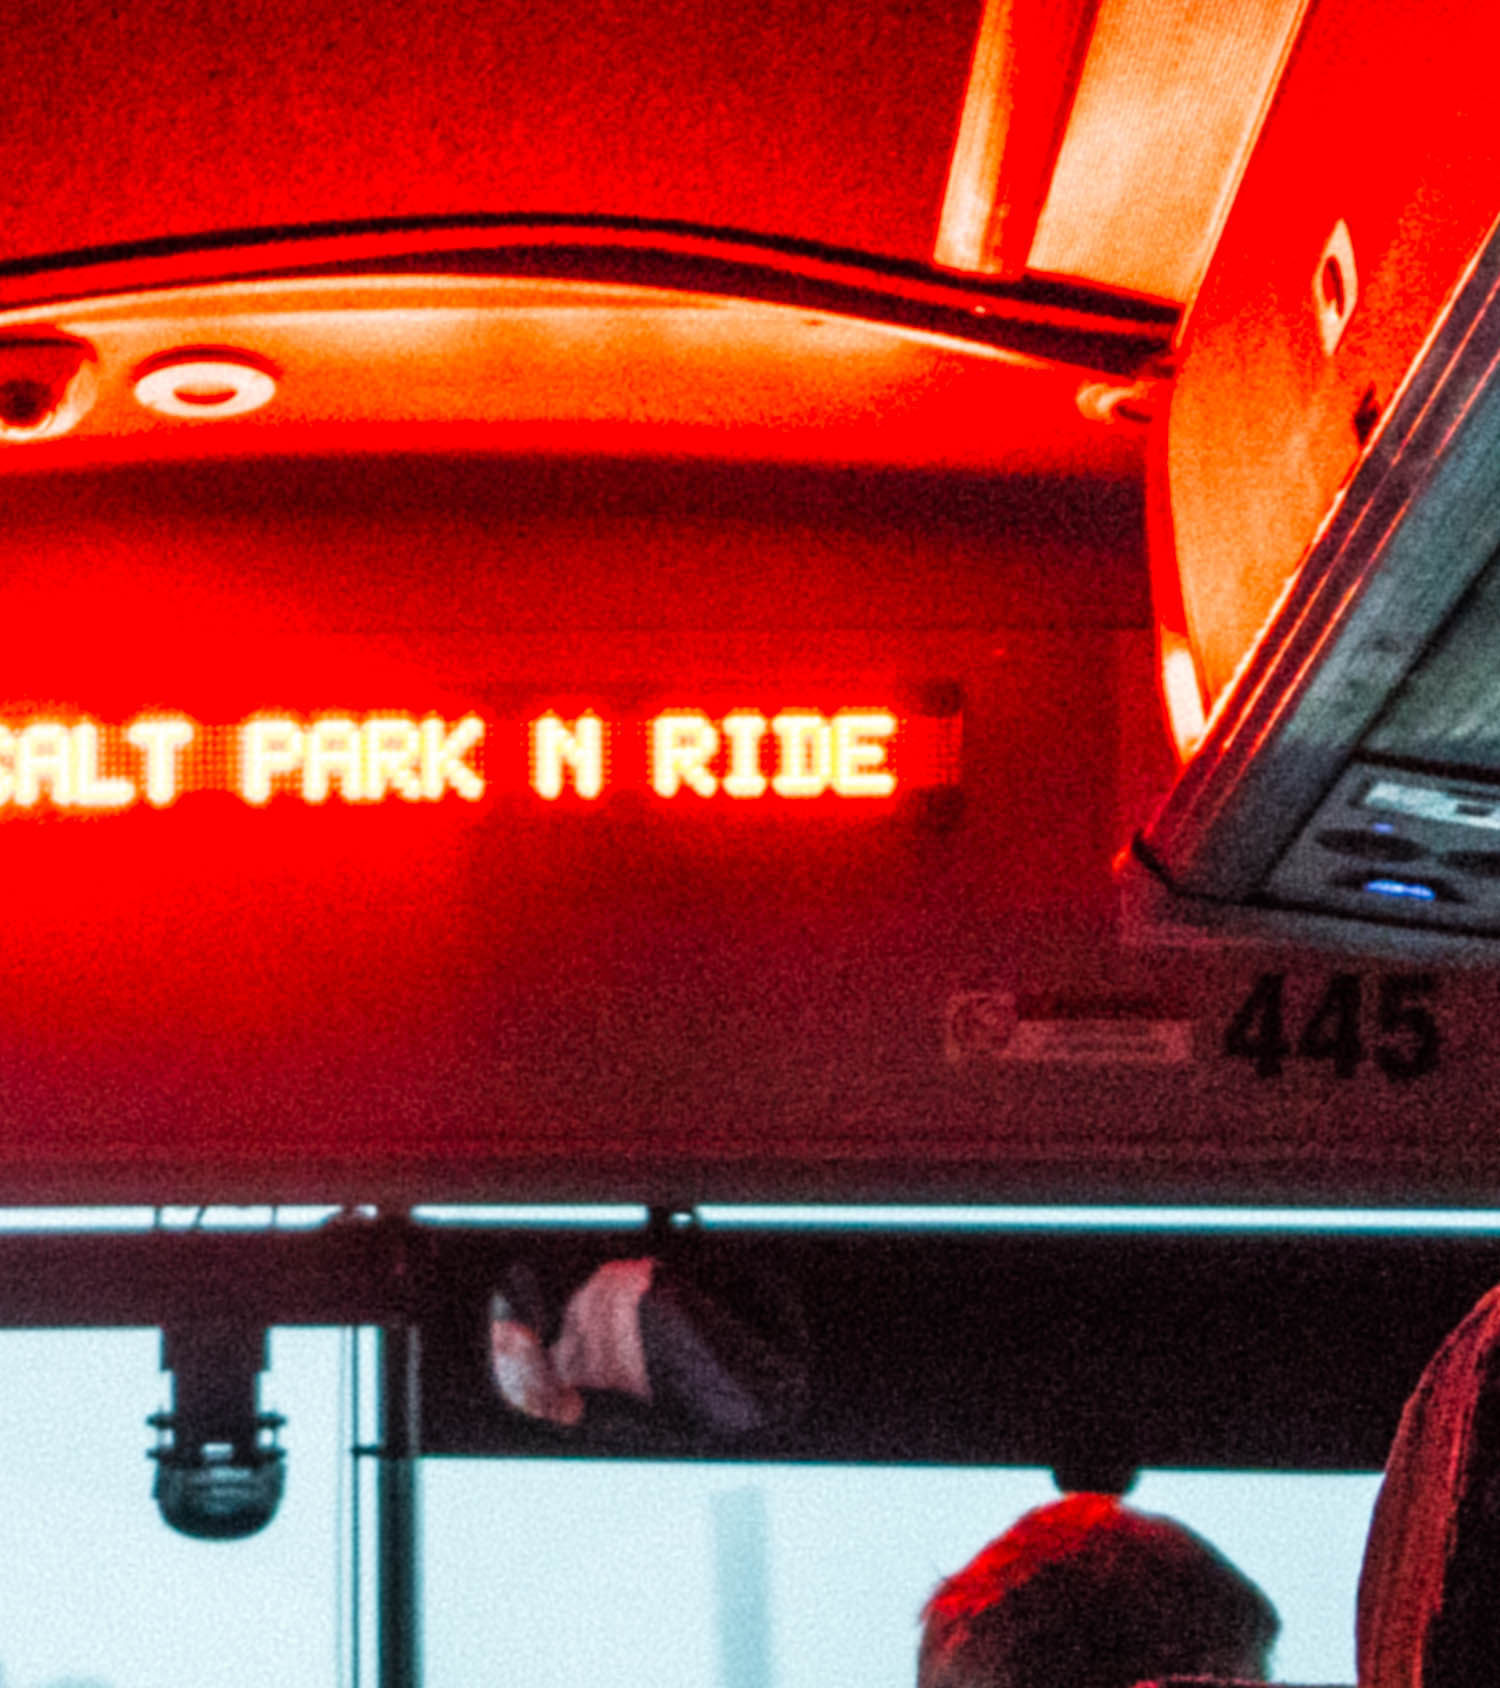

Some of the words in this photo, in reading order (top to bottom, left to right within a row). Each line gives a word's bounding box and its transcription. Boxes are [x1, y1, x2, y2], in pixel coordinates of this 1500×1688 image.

[239, 715, 484, 803] PARK
[532, 712, 602, 799] N
[651, 712, 899, 798] RIDE
[1222, 971, 1441, 1082] 445
